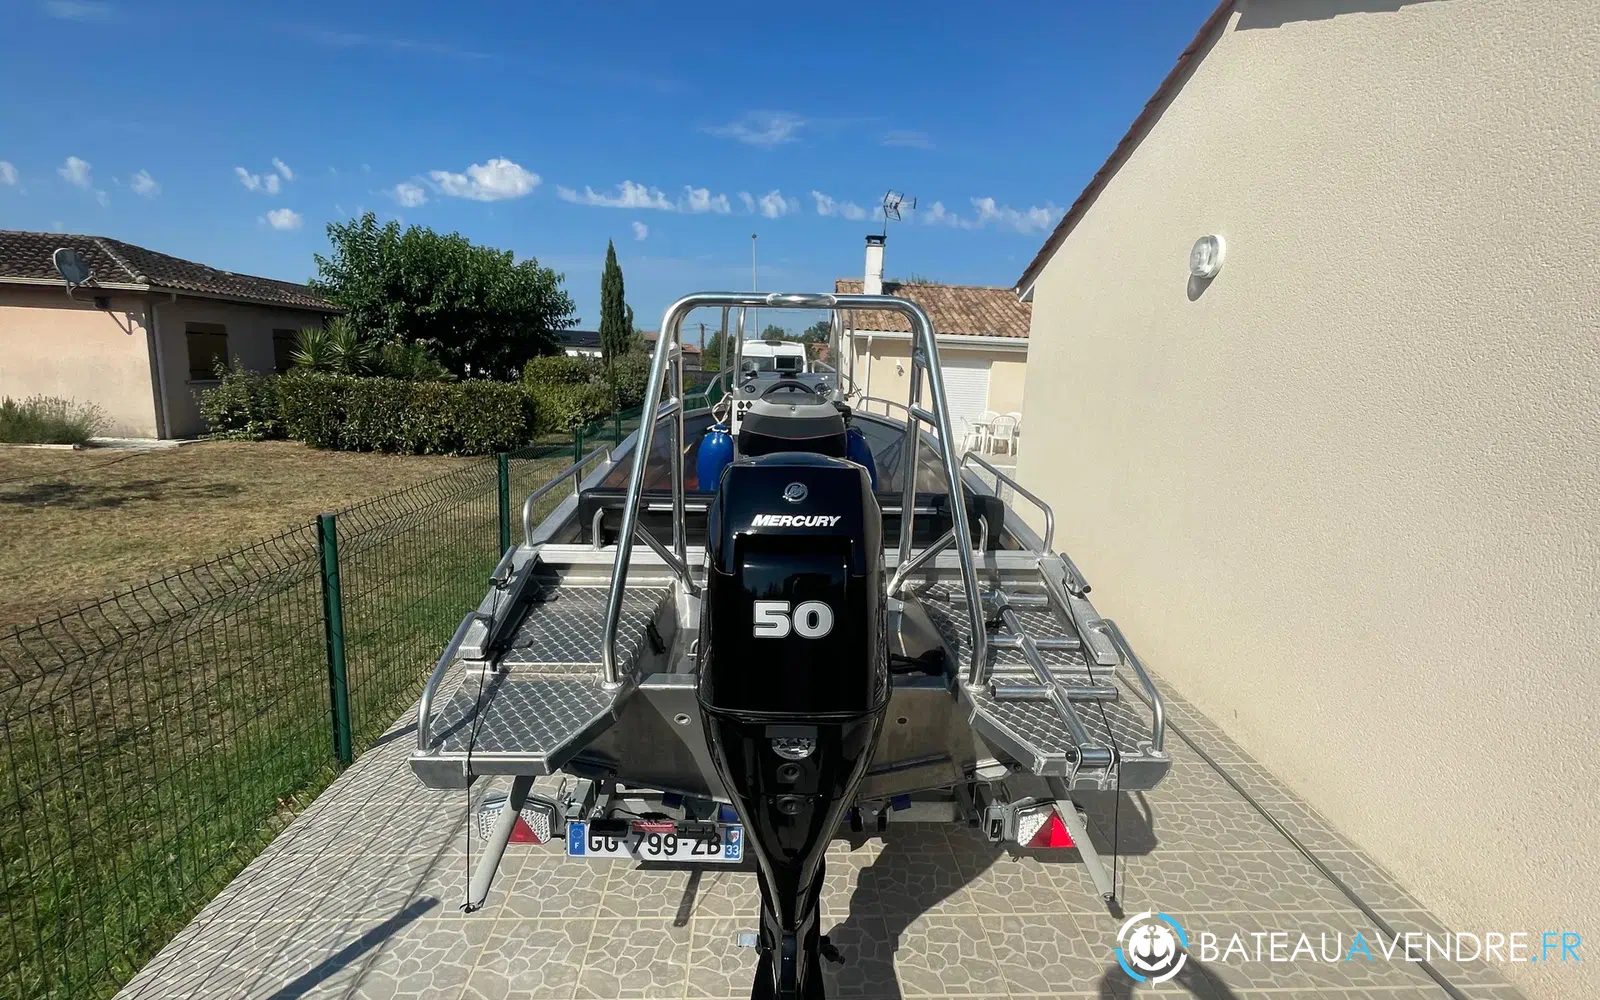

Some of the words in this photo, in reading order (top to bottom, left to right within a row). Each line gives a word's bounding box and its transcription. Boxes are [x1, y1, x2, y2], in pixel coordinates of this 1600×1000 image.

[751, 514, 841, 527] MERCURY
[753, 600, 834, 639] 50
[574, 841, 580, 849] F
[726, 844, 739, 856] 33
